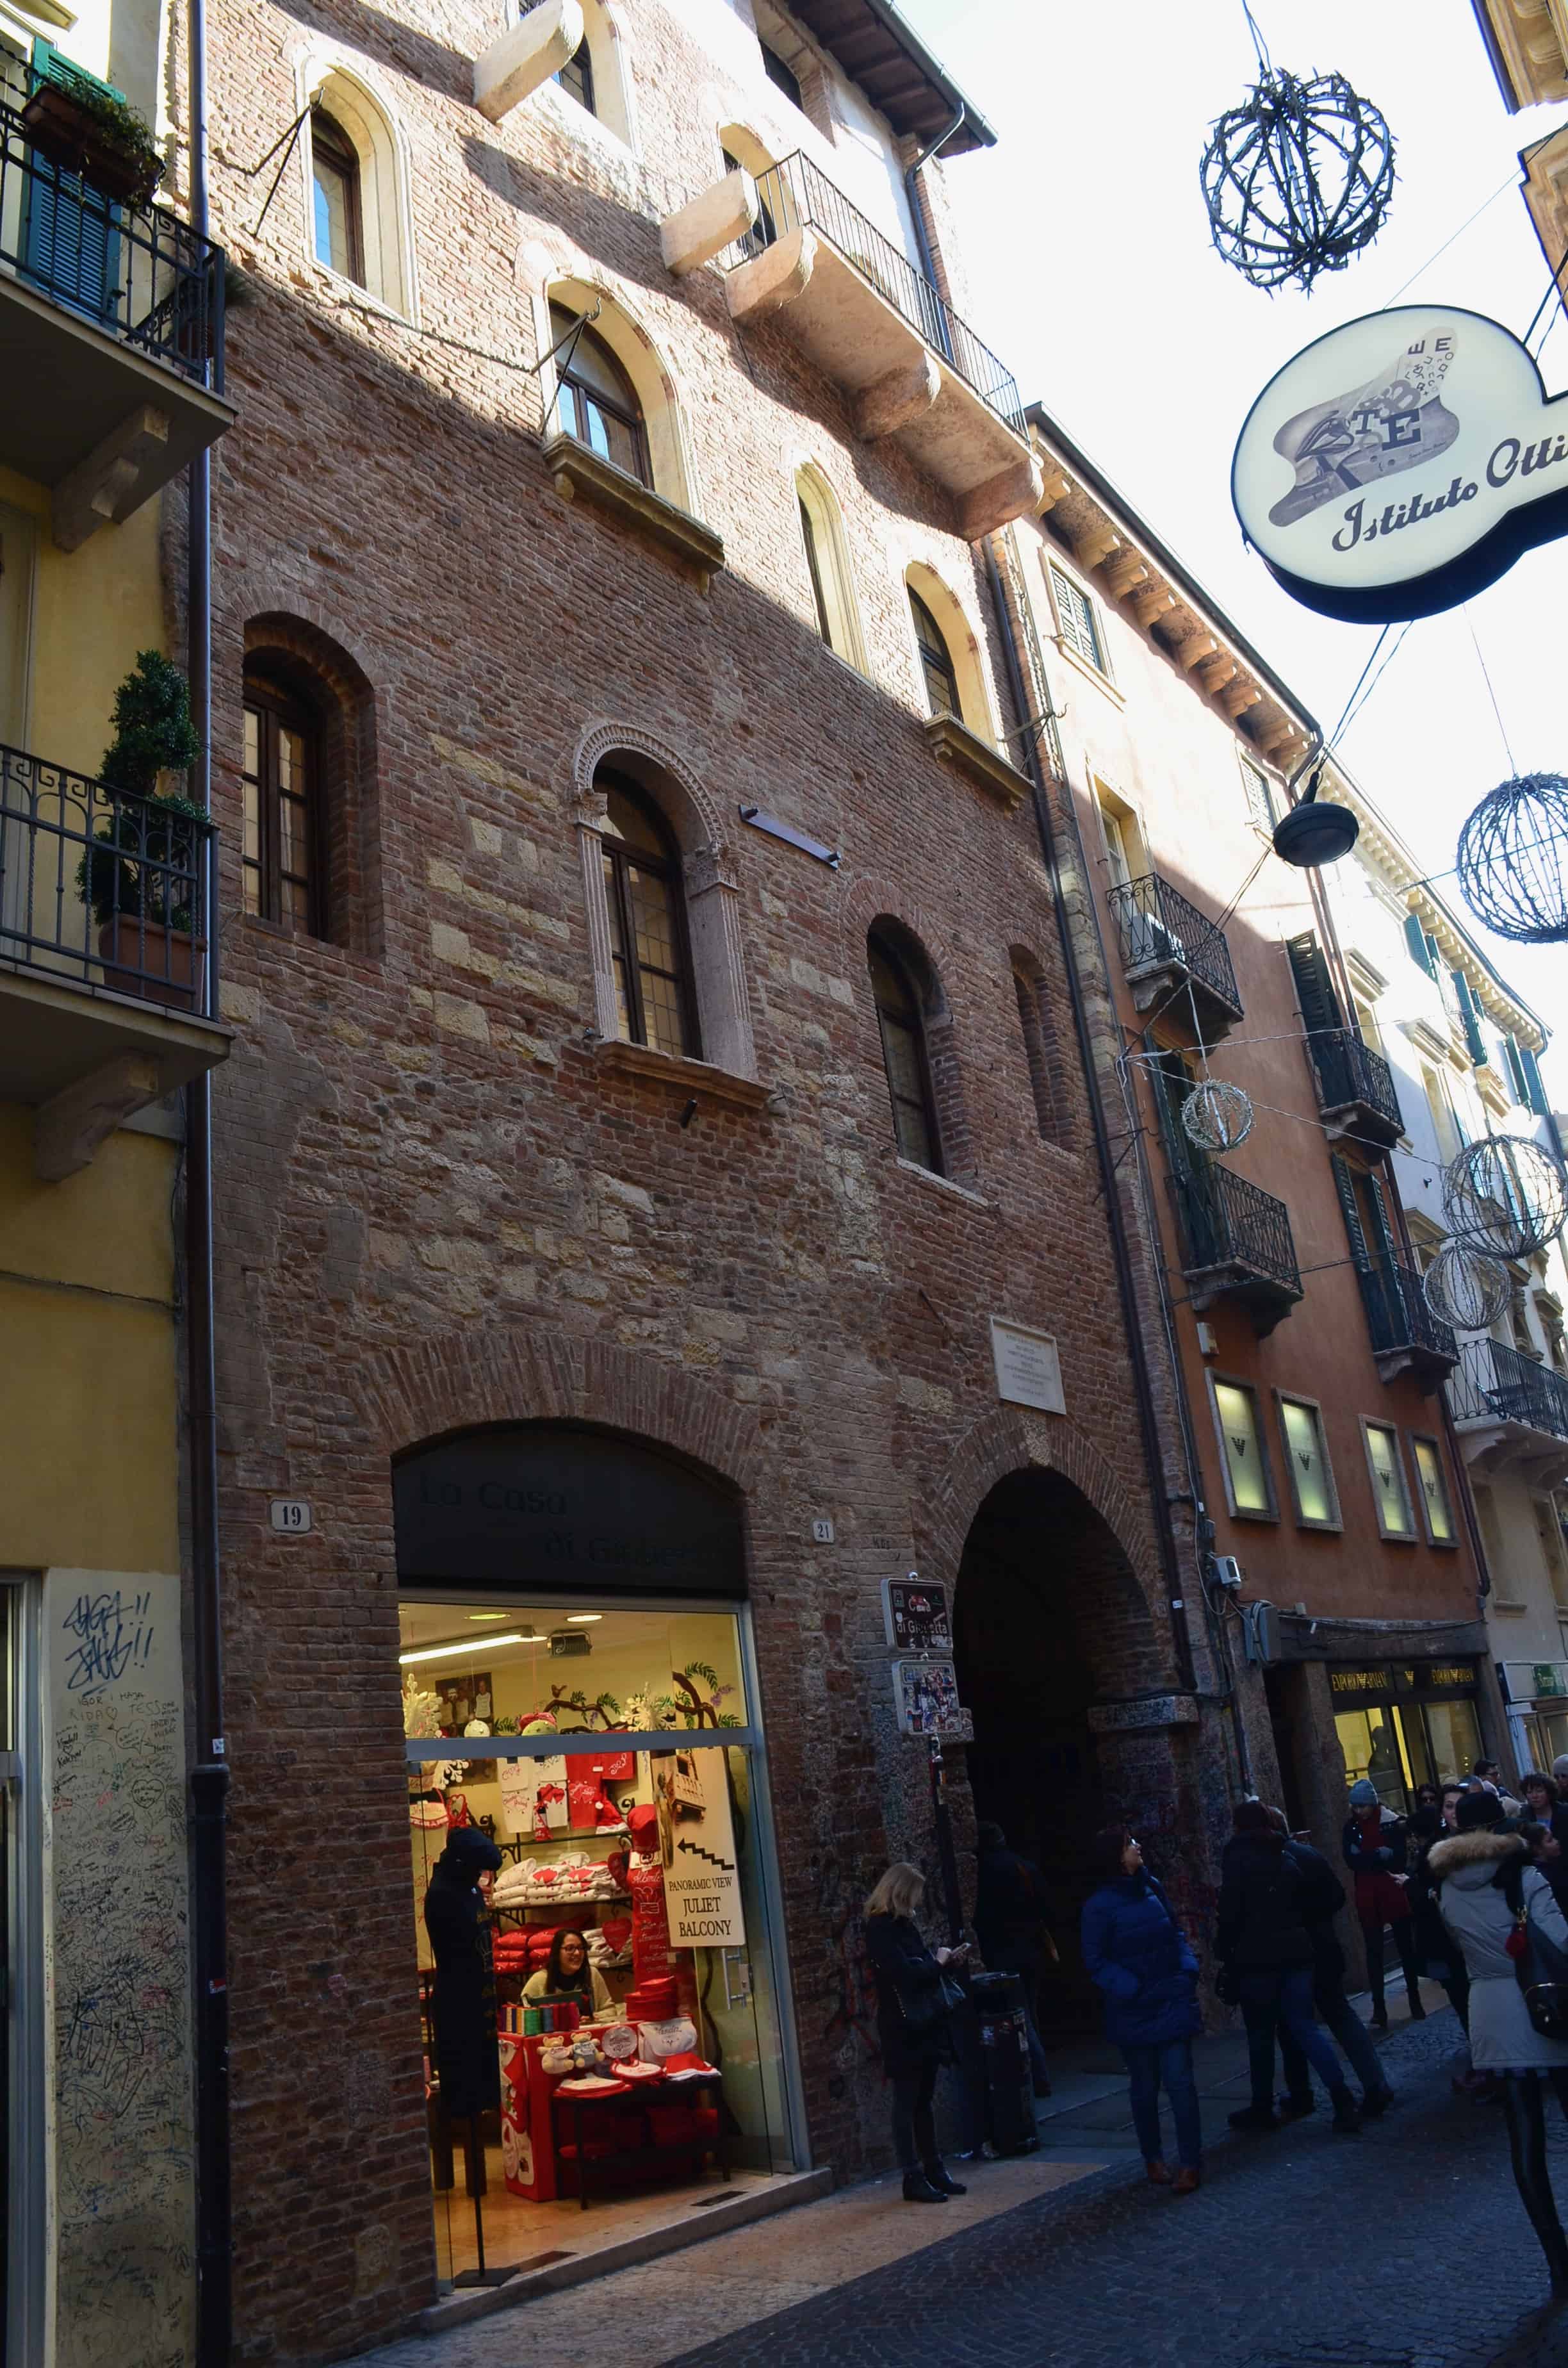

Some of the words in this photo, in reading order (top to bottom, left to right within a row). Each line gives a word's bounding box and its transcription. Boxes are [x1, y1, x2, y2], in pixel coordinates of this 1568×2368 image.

[1332, 477, 1478, 552] Istituto
[282, 1506, 302, 1526] 19
[817, 1523, 829, 1538] 21
[669, 1878, 711, 1891] PANORAMIC
[711, 1876, 733, 1889] VIEW
[683, 1896, 721, 1917] JULIET
[679, 1920, 731, 1938] BALCONY
